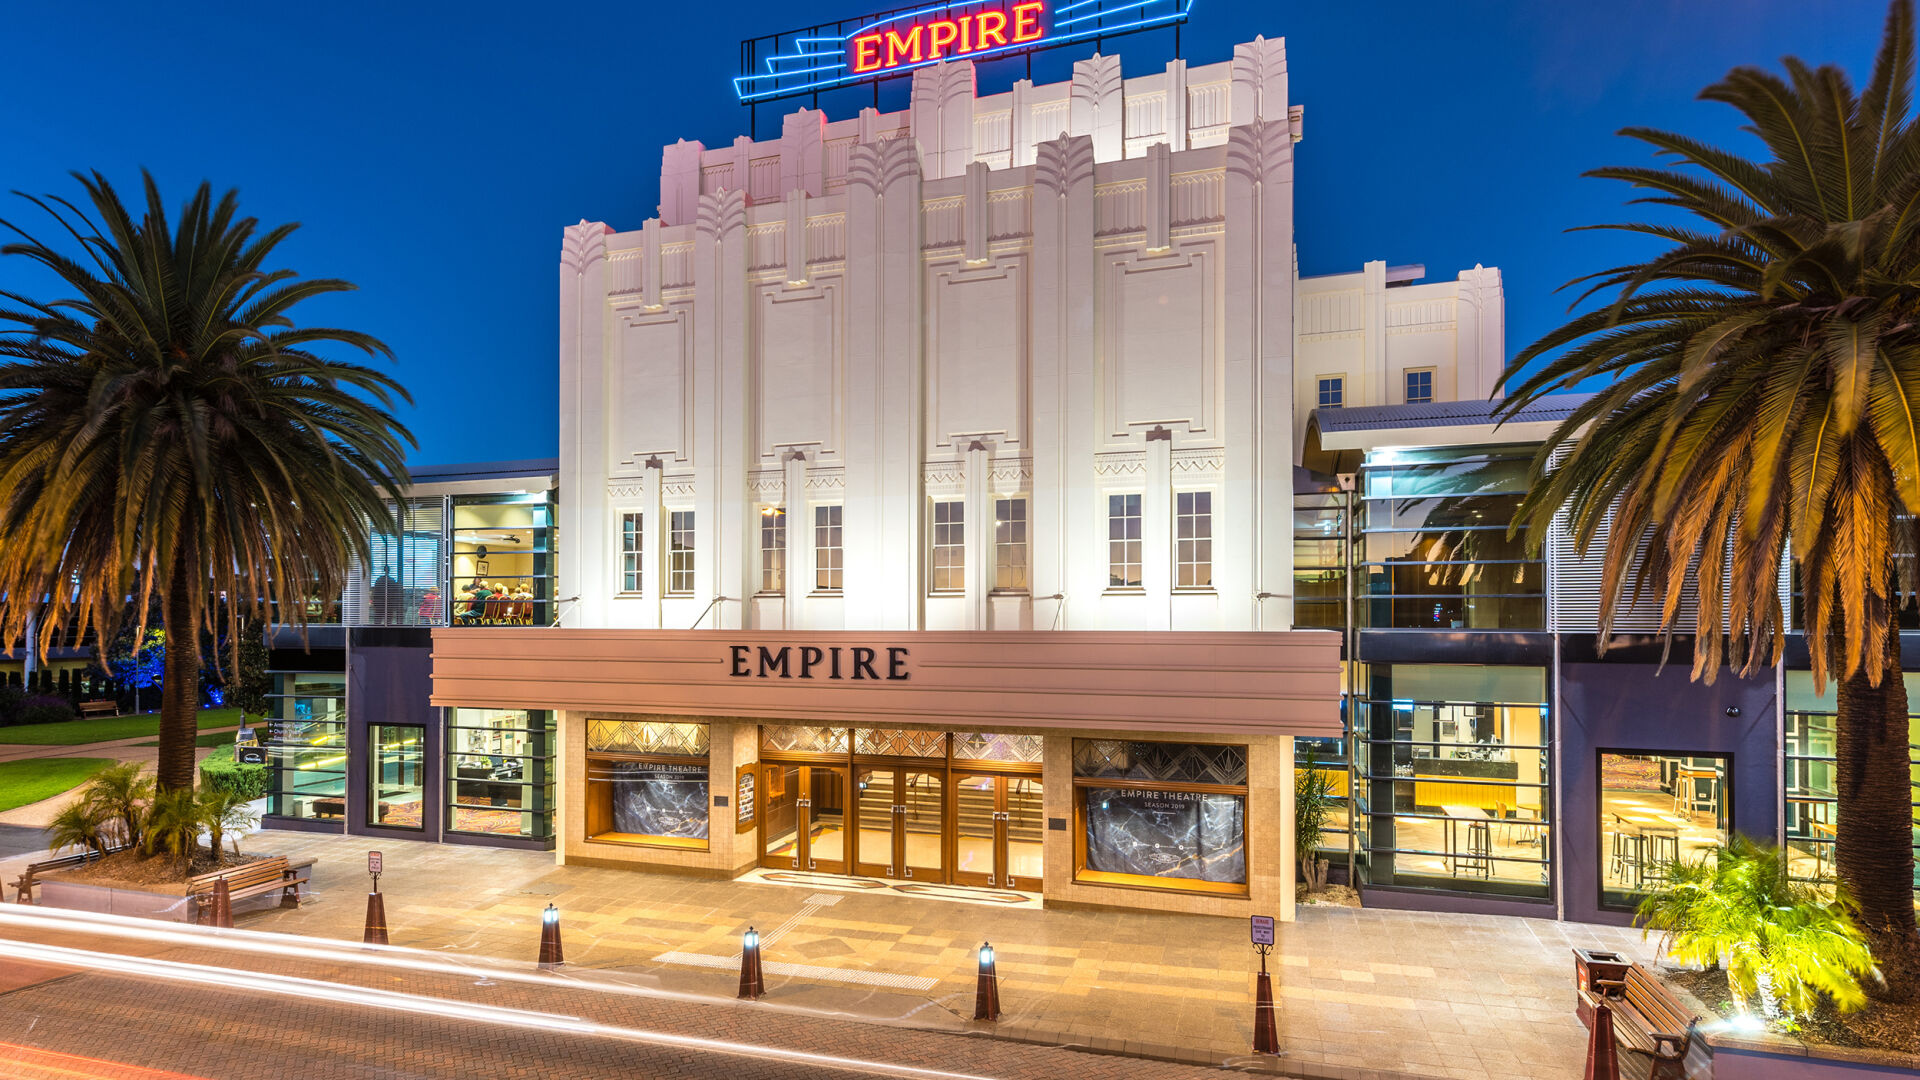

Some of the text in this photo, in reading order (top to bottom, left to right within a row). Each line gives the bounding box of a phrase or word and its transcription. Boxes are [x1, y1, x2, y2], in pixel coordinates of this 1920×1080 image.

[854, 2, 1043, 73] EMPIRE
[729, 645, 910, 680] EMPIRE
[638, 762, 702, 774] EMPIRE THEATRE
[1121, 789, 1208, 802] EMPIRE THEATRE
[1144, 801, 1170, 809] SEASON
